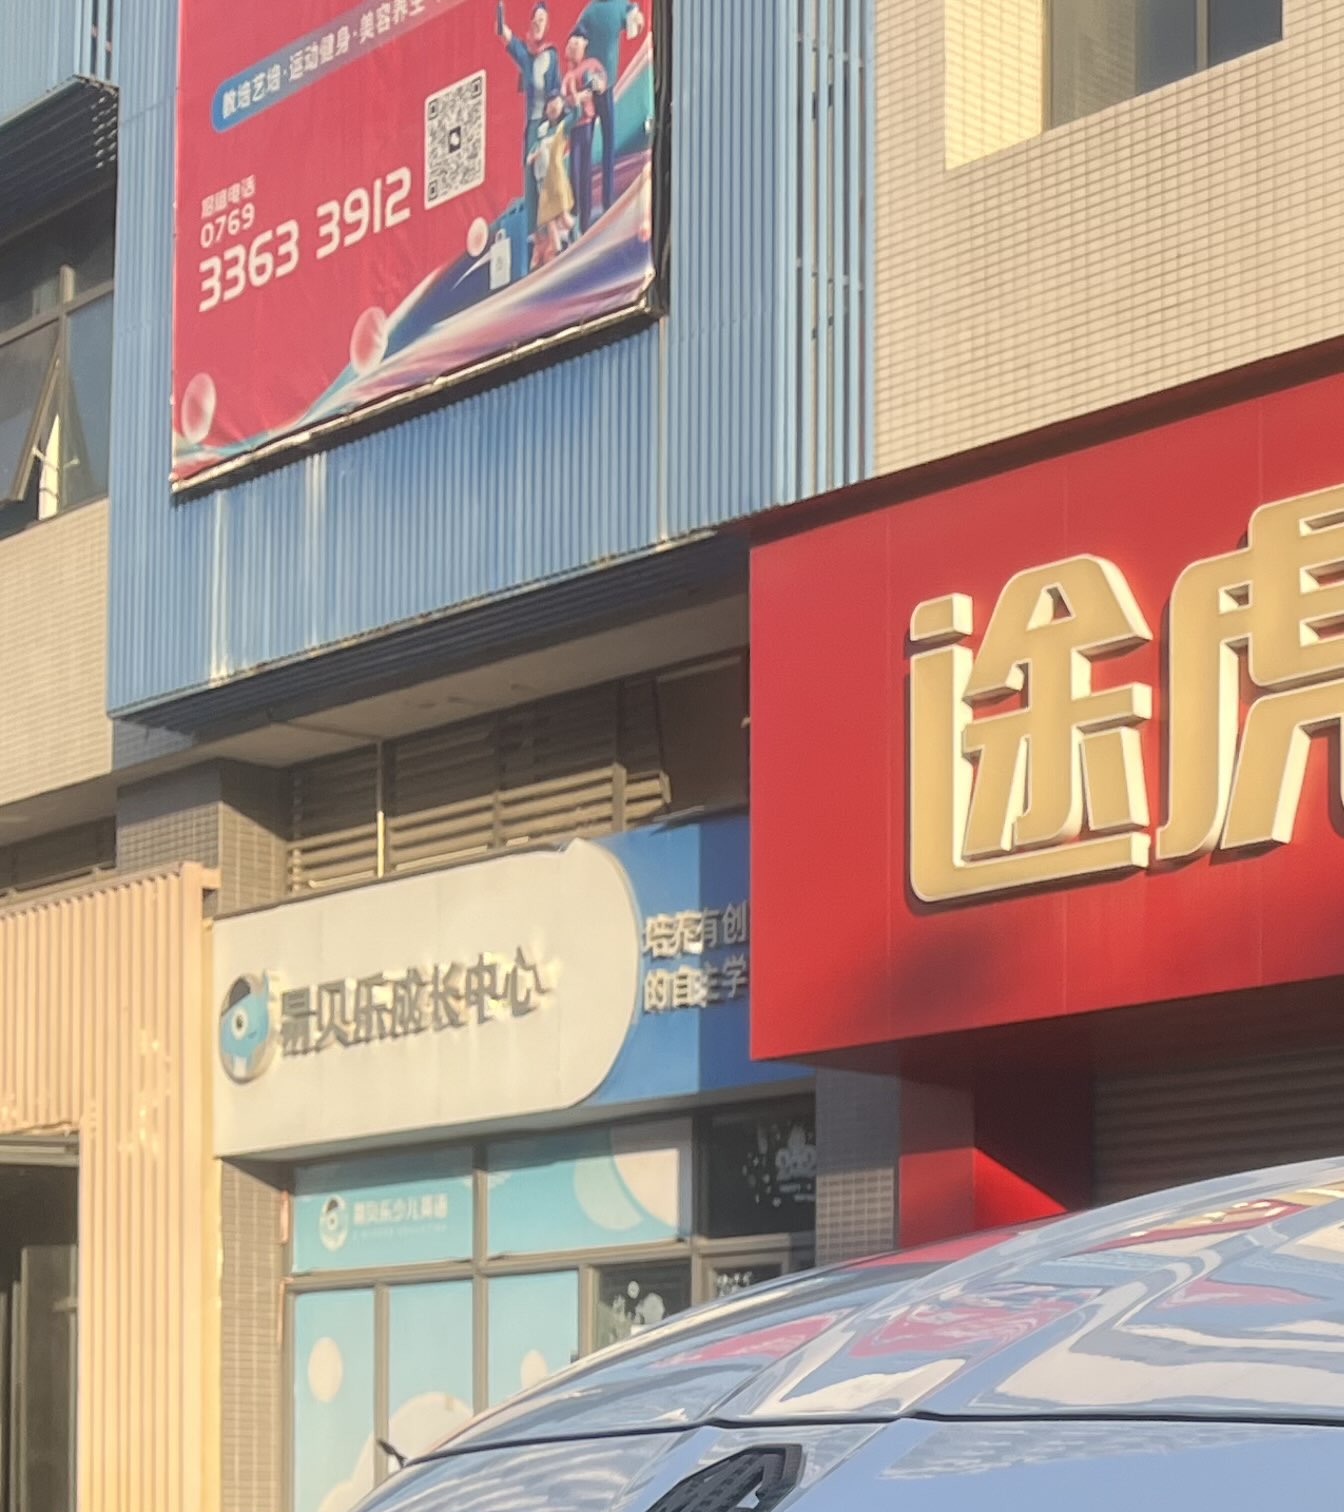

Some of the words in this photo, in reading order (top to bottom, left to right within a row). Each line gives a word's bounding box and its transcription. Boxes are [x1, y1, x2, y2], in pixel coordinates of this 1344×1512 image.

[199, 219, 299, 312] 3363
[316, 166, 411, 259] 3912
[200, 202, 255, 248] 0769
